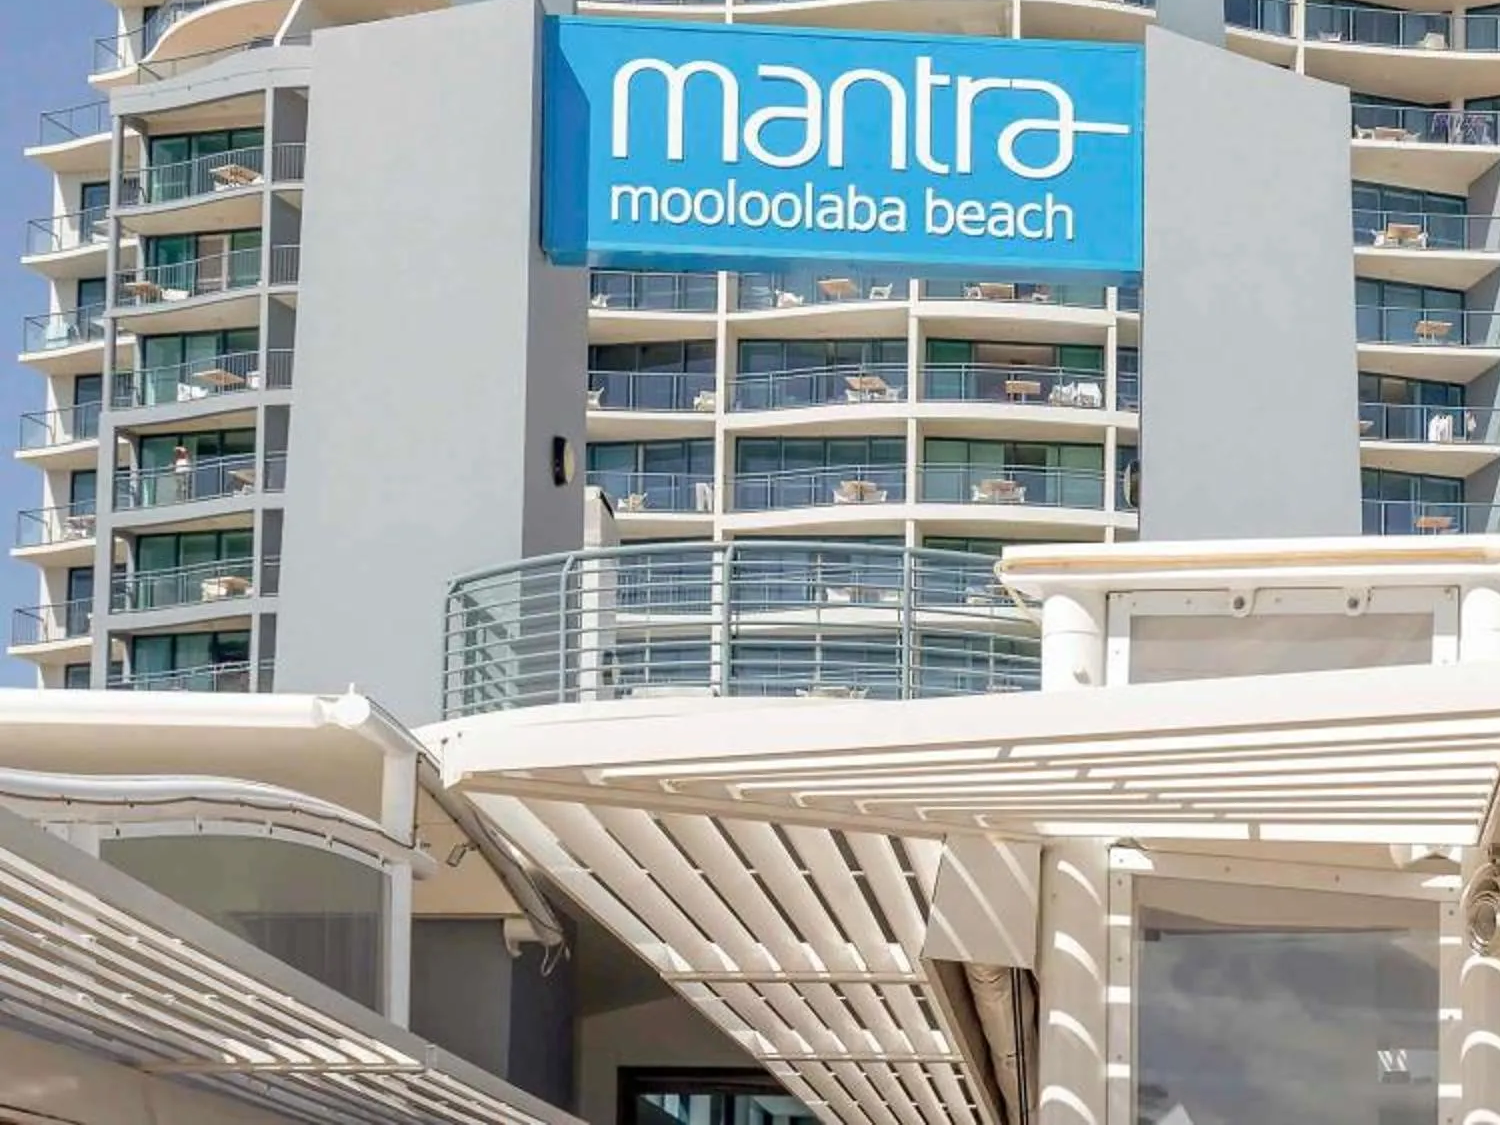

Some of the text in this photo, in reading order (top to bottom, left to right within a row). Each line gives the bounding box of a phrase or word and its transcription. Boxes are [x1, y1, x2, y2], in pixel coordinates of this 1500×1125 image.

[611, 57, 1130, 179] mantra
[610, 178, 1074, 241] mooloolaba beach
